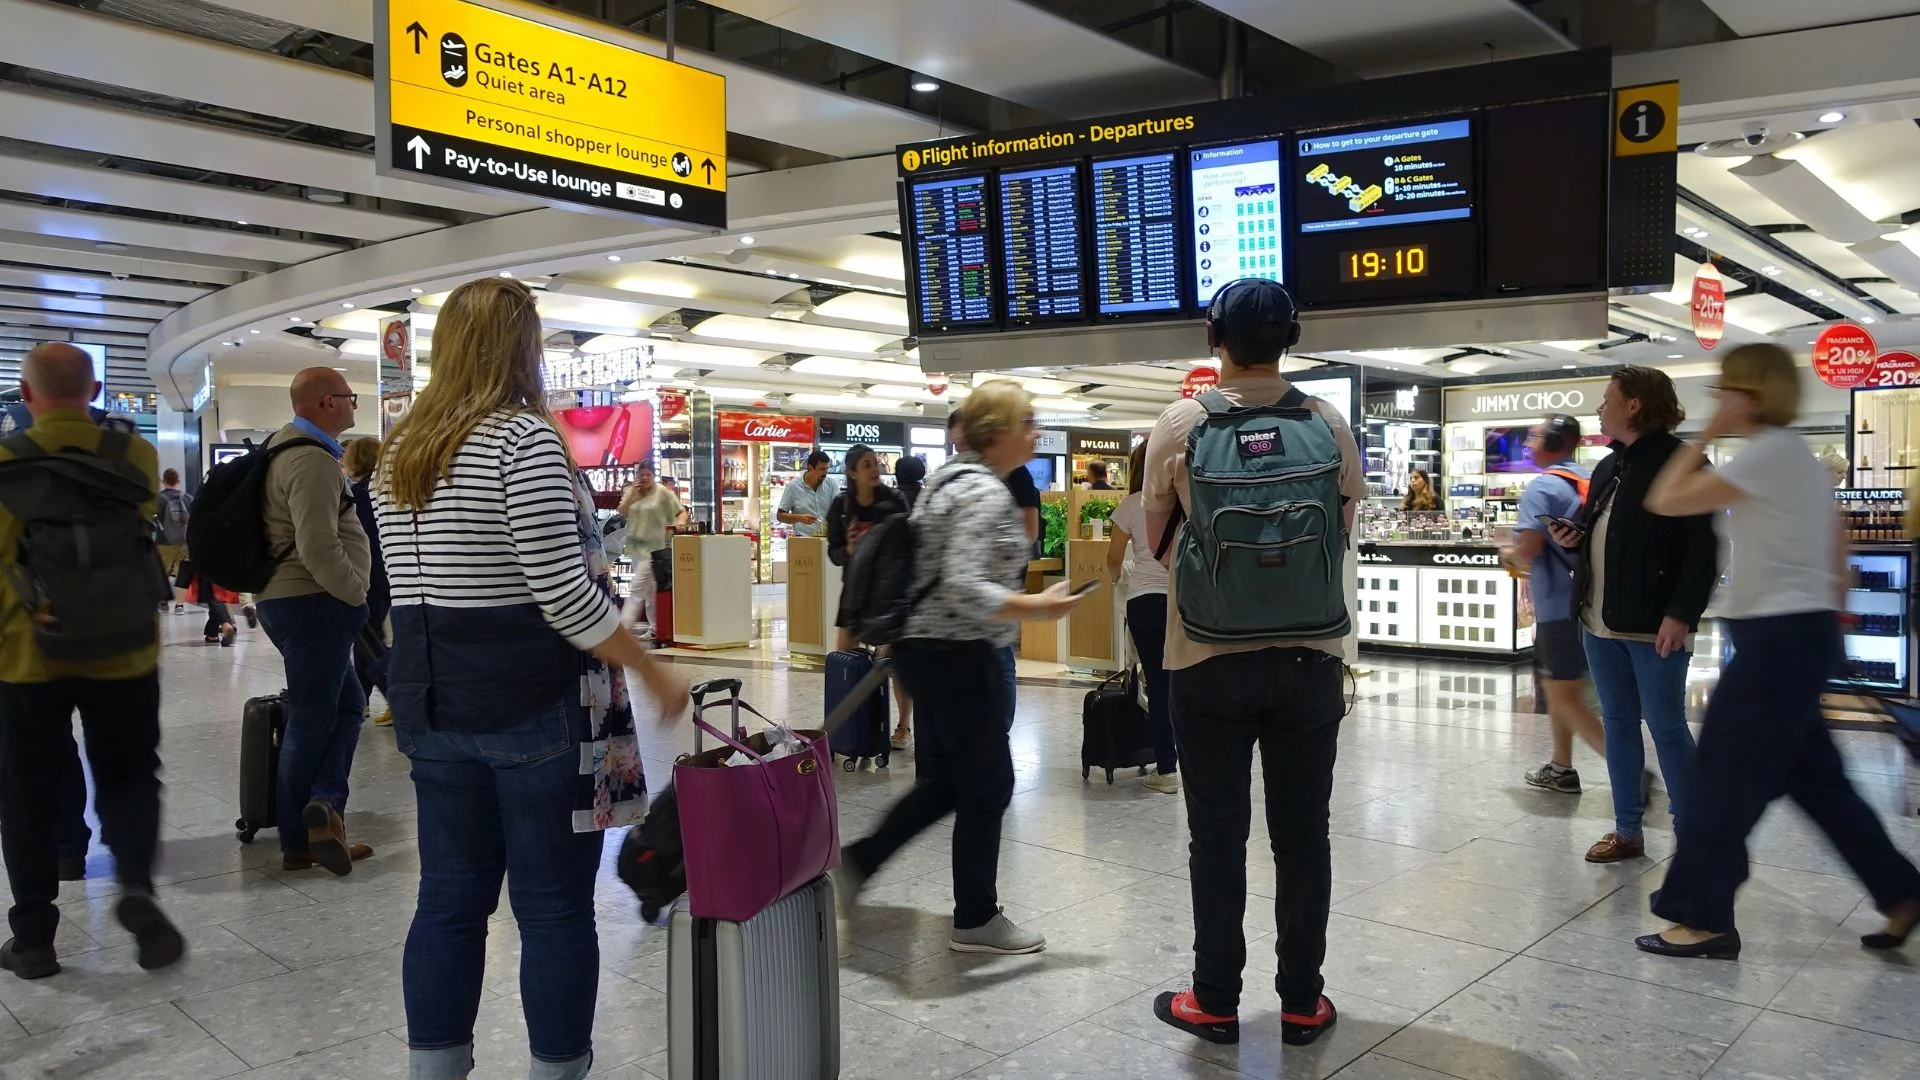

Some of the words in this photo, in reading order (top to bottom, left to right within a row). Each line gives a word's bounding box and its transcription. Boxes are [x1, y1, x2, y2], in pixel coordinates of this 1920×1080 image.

[475, 42, 541, 77] Gates
[547, 61, 628, 99] A1-A12
[475, 70, 525, 96] Quiet
[528, 86, 566, 106] area
[466, 109, 541, 140] Personal
[546, 127, 612, 156] shopper
[616, 142, 669, 170] lounge
[922, 147, 970, 166] Flight
[972, 129, 1075, 158] information
[1090, 115, 1195, 144] Departures
[1313, 141, 1331, 150] How
[1331, 140, 1340, 148] to
[1341, 138, 1354, 148] get
[1354, 137, 1363, 145] to
[1363, 135, 1382, 145] your
[1382, 131, 1421, 143] departure
[1421, 128, 1439, 139] gate
[1202, 148, 1244, 160] Information
[1400, 154, 1422, 163] Gates
[444, 148, 549, 185] Pay-to-Use
[551, 166, 612, 197] lounge
[1394, 164, 1404, 172] 10
[1404, 161, 1433, 171] minutes
[1412, 174, 1434, 183] Gates
[1394, 184, 1412, 192] 5-10
[1412, 182, 1441, 191] minutes
[1395, 192, 1416, 200] 10-20
[1416, 190, 1445, 199] minutes
[1351, 248, 1424, 278] 19:10
[1820, 346, 1872, 366] -20%
[1876, 361, 1916, 369] FRAGRANCE
[1869, 369, 1920, 387] -20%
[1471, 394, 1521, 413] JIMMY
[1523, 390, 1584, 410] CHOO
[744, 418, 792, 438] Cartier
[846, 423, 880, 438] BOSS
[1080, 439, 1120, 450] BVLGARI
[1239, 431, 1277, 445] poker
[1834, 490, 1863, 499] ESTEE
[1863, 490, 1903, 499] LAUDER
[1432, 553, 1499, 565] COACH
